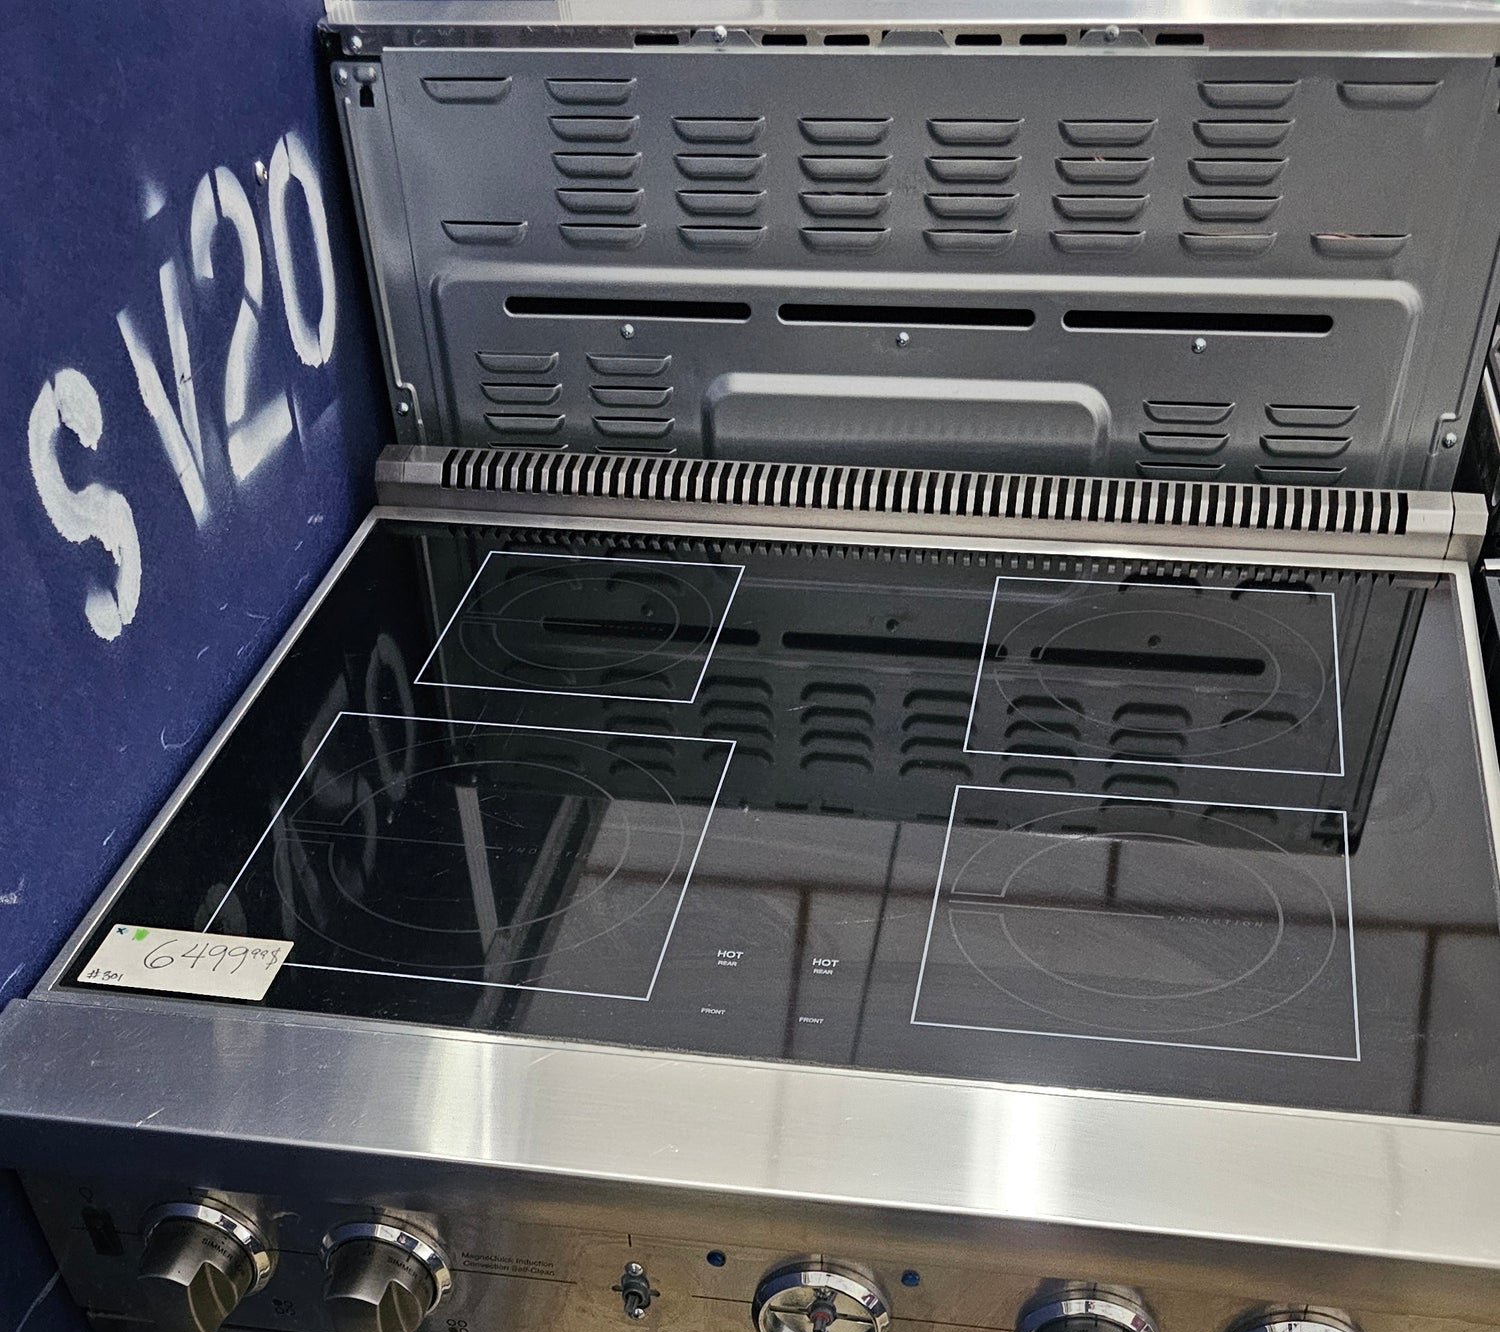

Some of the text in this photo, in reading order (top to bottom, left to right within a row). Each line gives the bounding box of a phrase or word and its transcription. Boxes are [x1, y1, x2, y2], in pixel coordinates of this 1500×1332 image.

[717, 949, 744, 960] HOT
[812, 957, 840, 968] HOT
[86, 968, 124, 982] #301
[813, 968, 834, 976] REAR
[700, 1007, 726, 1015] FRONT
[798, 1016, 825, 1025] FRONT
[201, 1237, 234, 1261] SIMMER
[515, 1258, 554, 1269] Induction
